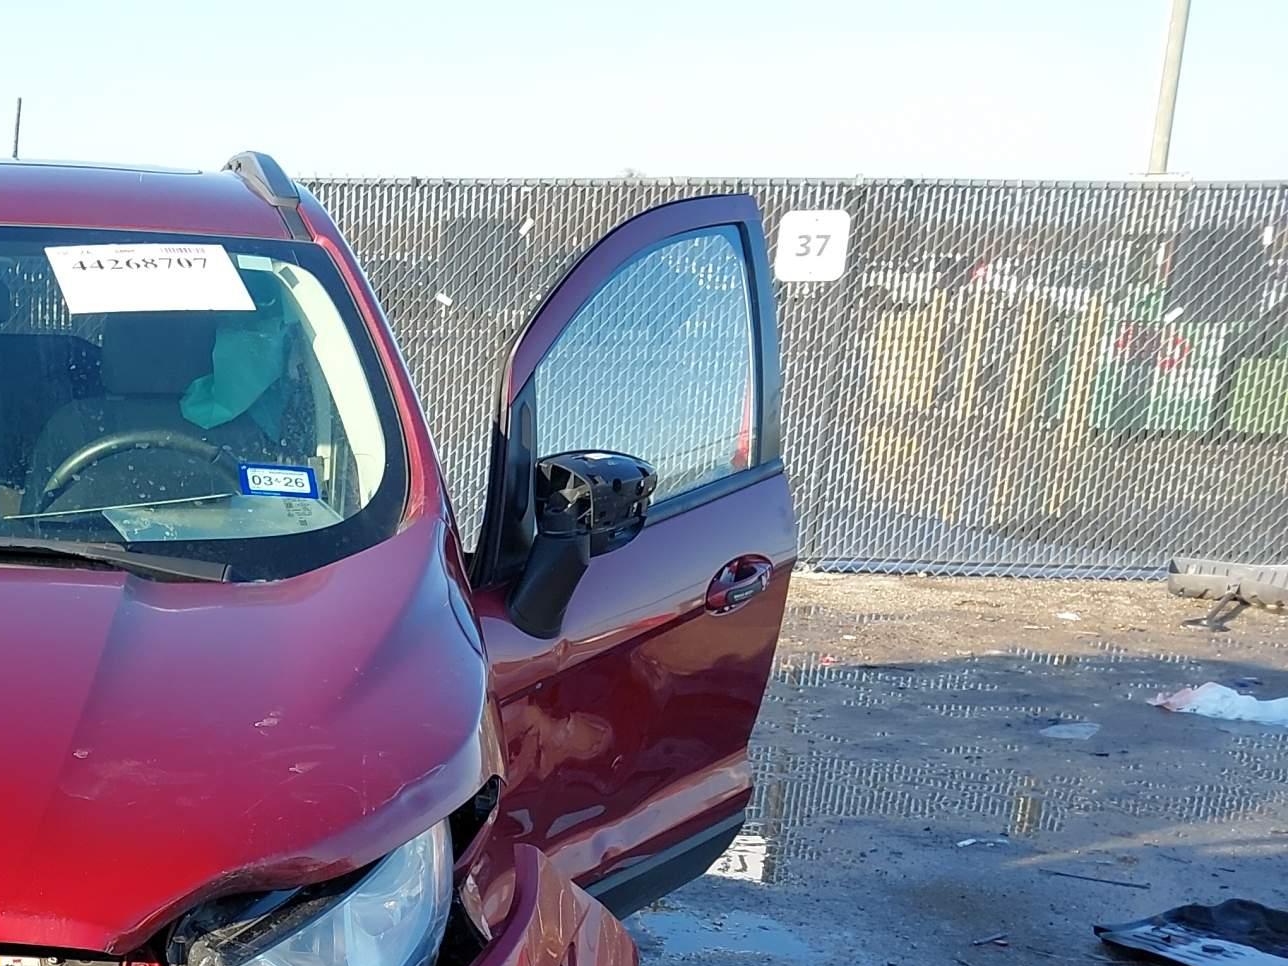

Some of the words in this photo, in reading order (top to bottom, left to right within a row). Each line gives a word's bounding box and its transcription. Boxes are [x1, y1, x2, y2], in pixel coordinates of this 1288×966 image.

[795, 234, 832, 257] 37
[72, 257, 207, 271] 44268707
[252, 475, 273, 486] 03
[283, 476, 305, 488] 26
